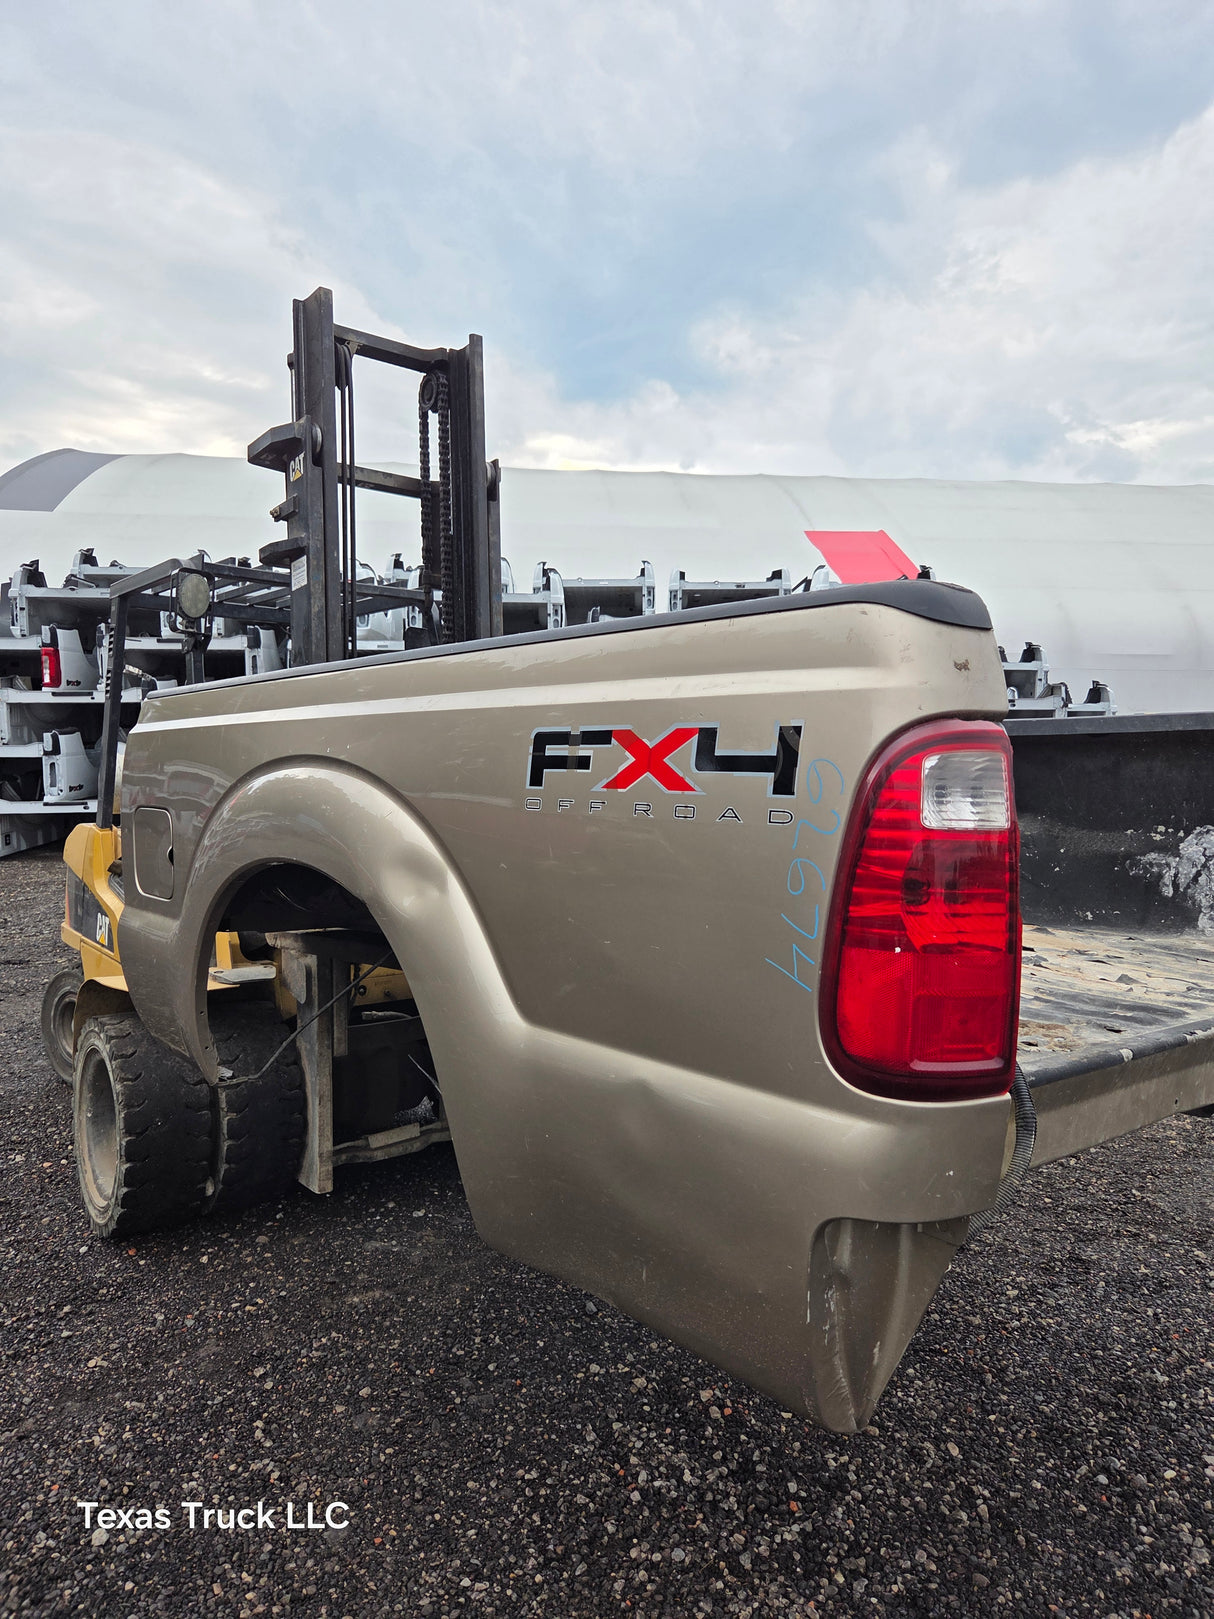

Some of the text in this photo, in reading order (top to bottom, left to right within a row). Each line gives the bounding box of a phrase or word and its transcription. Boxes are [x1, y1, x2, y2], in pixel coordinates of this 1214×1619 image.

[289, 451, 305, 482] CAT
[526, 719, 804, 798] FX4
[765, 758, 844, 992] 62674
[96, 912, 110, 946] CAT
